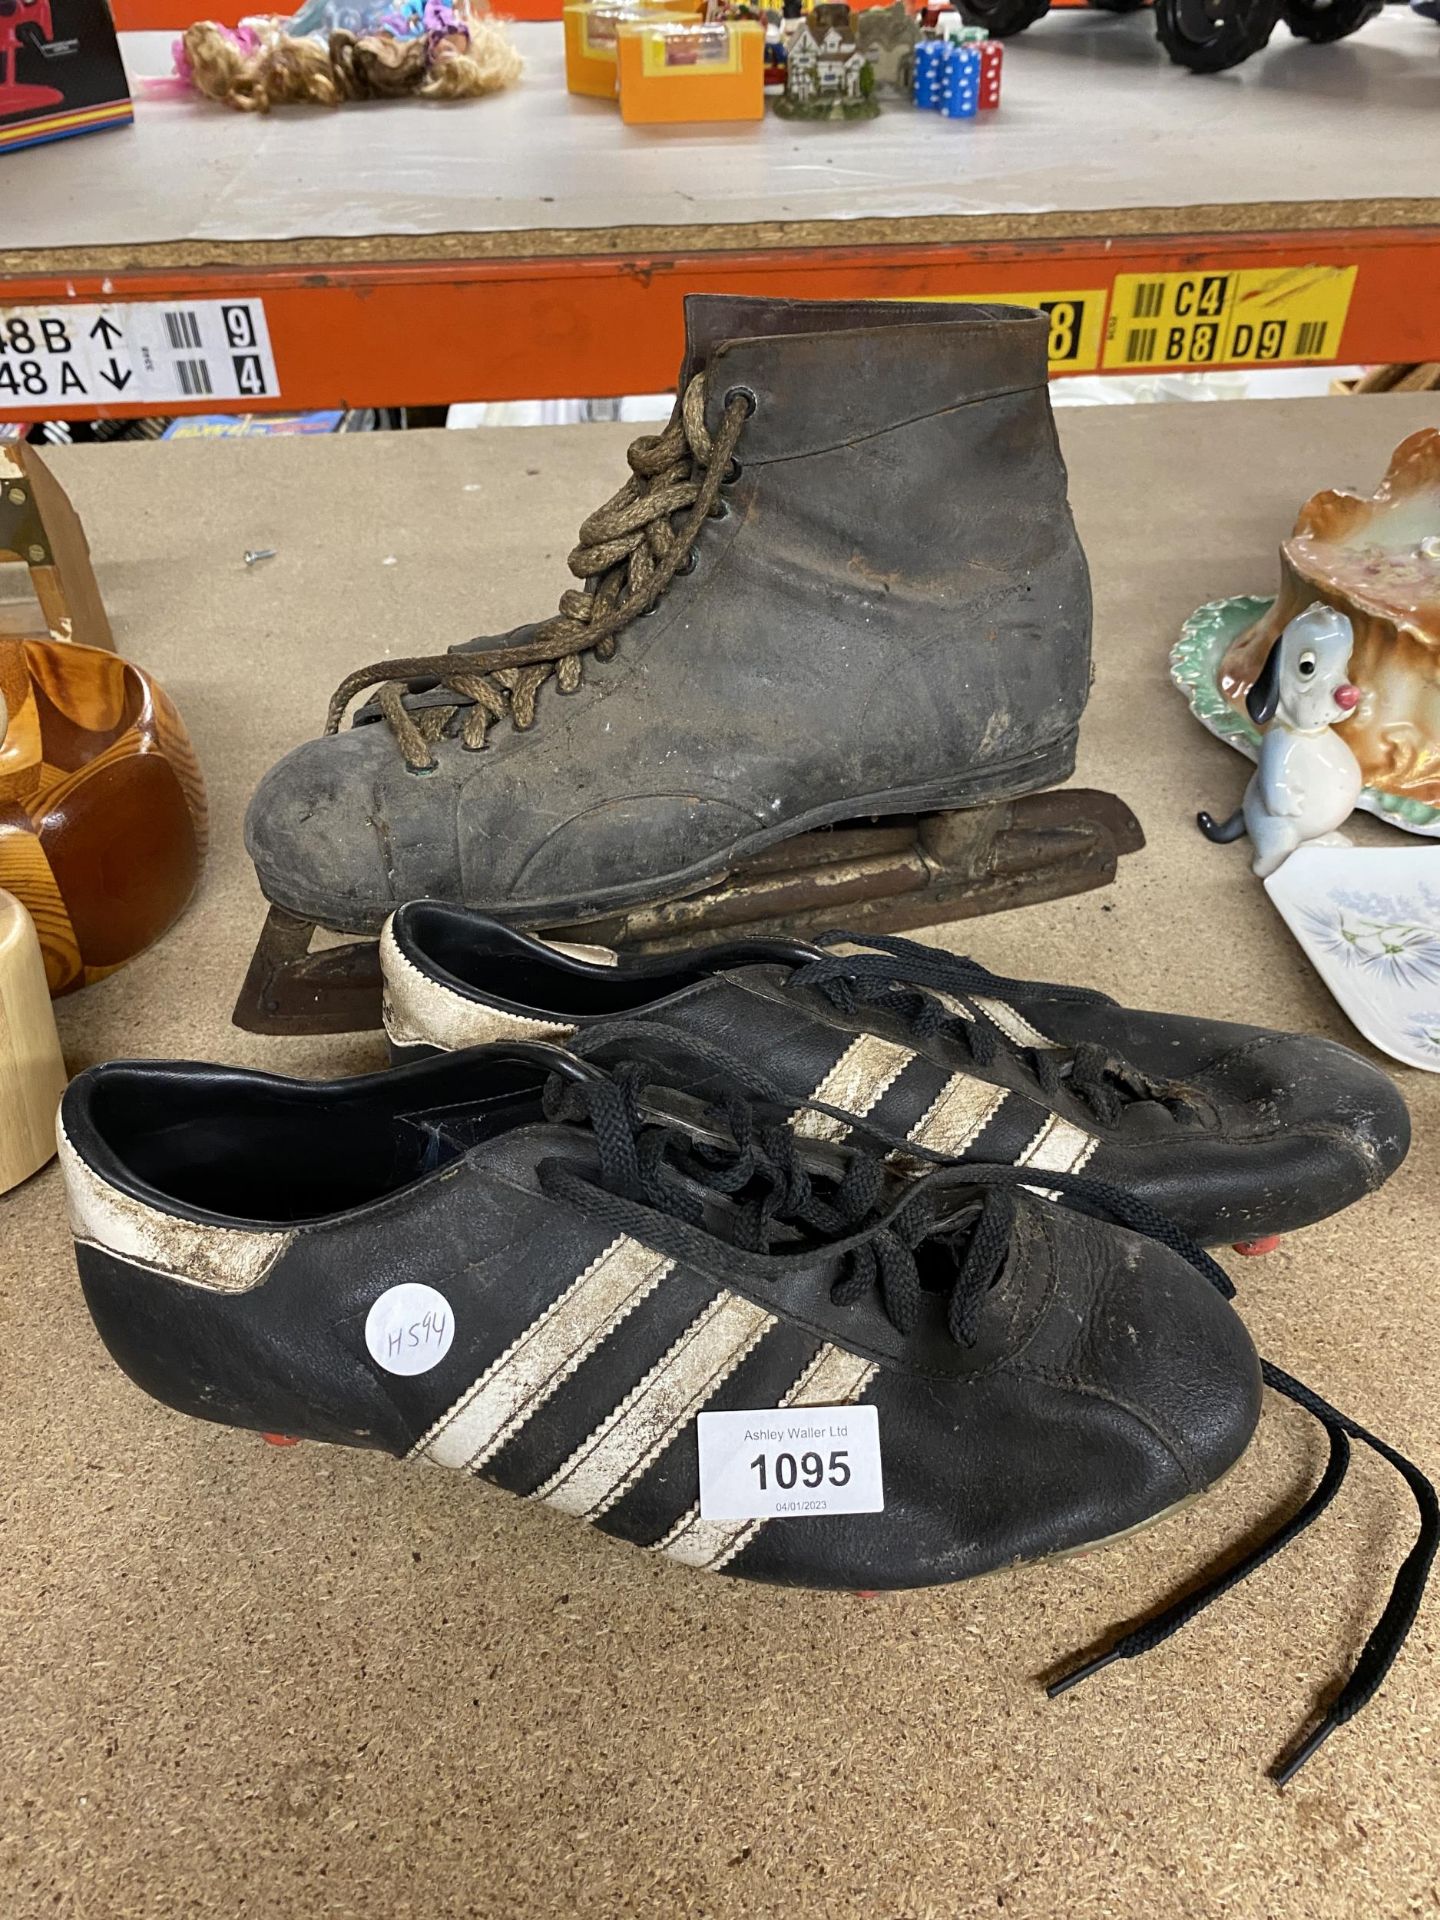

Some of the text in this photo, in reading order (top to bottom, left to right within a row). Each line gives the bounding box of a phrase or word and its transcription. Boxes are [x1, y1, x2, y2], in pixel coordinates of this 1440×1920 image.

[1175, 278, 1227, 316] C4
[39, 318, 71, 354] B
[226, 307, 254, 347] 9
[1166, 323, 1217, 362] B8
[1231, 320, 1285, 359] D9
[61, 361, 88, 395] A
[238, 356, 264, 393] 4
[744, 1425, 849, 1443] Ashley Waller Ltd
[751, 1450, 852, 1491] 1095
[775, 1500, 828, 1513] 04/01/2023
